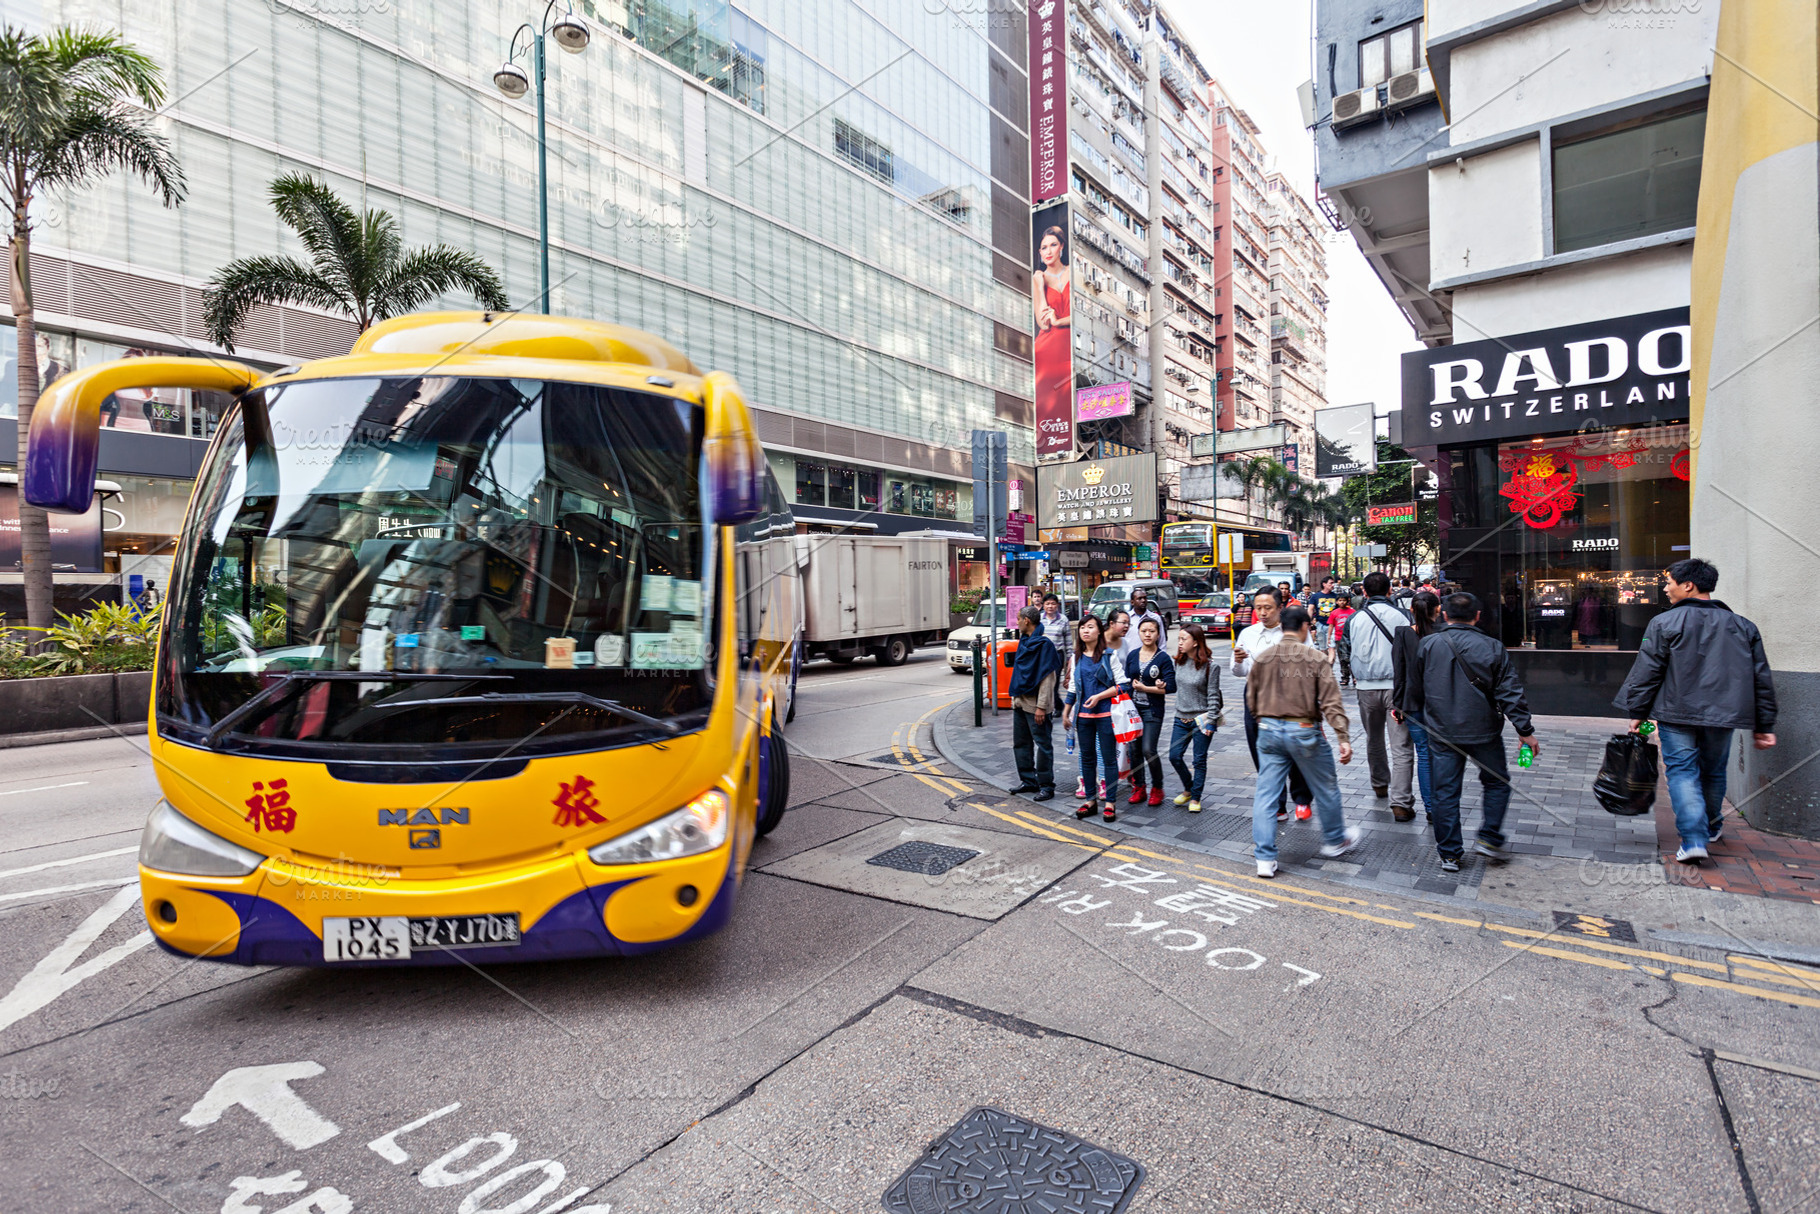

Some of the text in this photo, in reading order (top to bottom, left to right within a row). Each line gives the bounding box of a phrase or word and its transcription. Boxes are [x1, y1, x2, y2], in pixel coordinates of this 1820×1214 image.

[1043, 114, 1055, 193] EMPEROR
[1429, 325, 1690, 406] RADO
[1098, 387, 1125, 397] SAUNA
[1430, 380, 1690, 428] SWITZERLAN
[153, 408, 180, 420] M&S
[1331, 462, 1359, 470] RADO
[1526, 453, 1556, 477] 福
[1057, 483, 1133, 502] EMPEROR
[1368, 506, 1413, 518] Canon
[1381, 515, 1395, 523] TAX
[1396, 514, 1413, 522] FREE
[1572, 538, 1619, 548] RADO
[909, 561, 942, 570] FAIRTON
[245, 775, 607, 834] 福 旅
[379, 807, 470, 826] MAN
[350, 918, 384, 938] PX
[336, 938, 400, 959] 1045
[1105, 911, 1321, 993] LOOK
